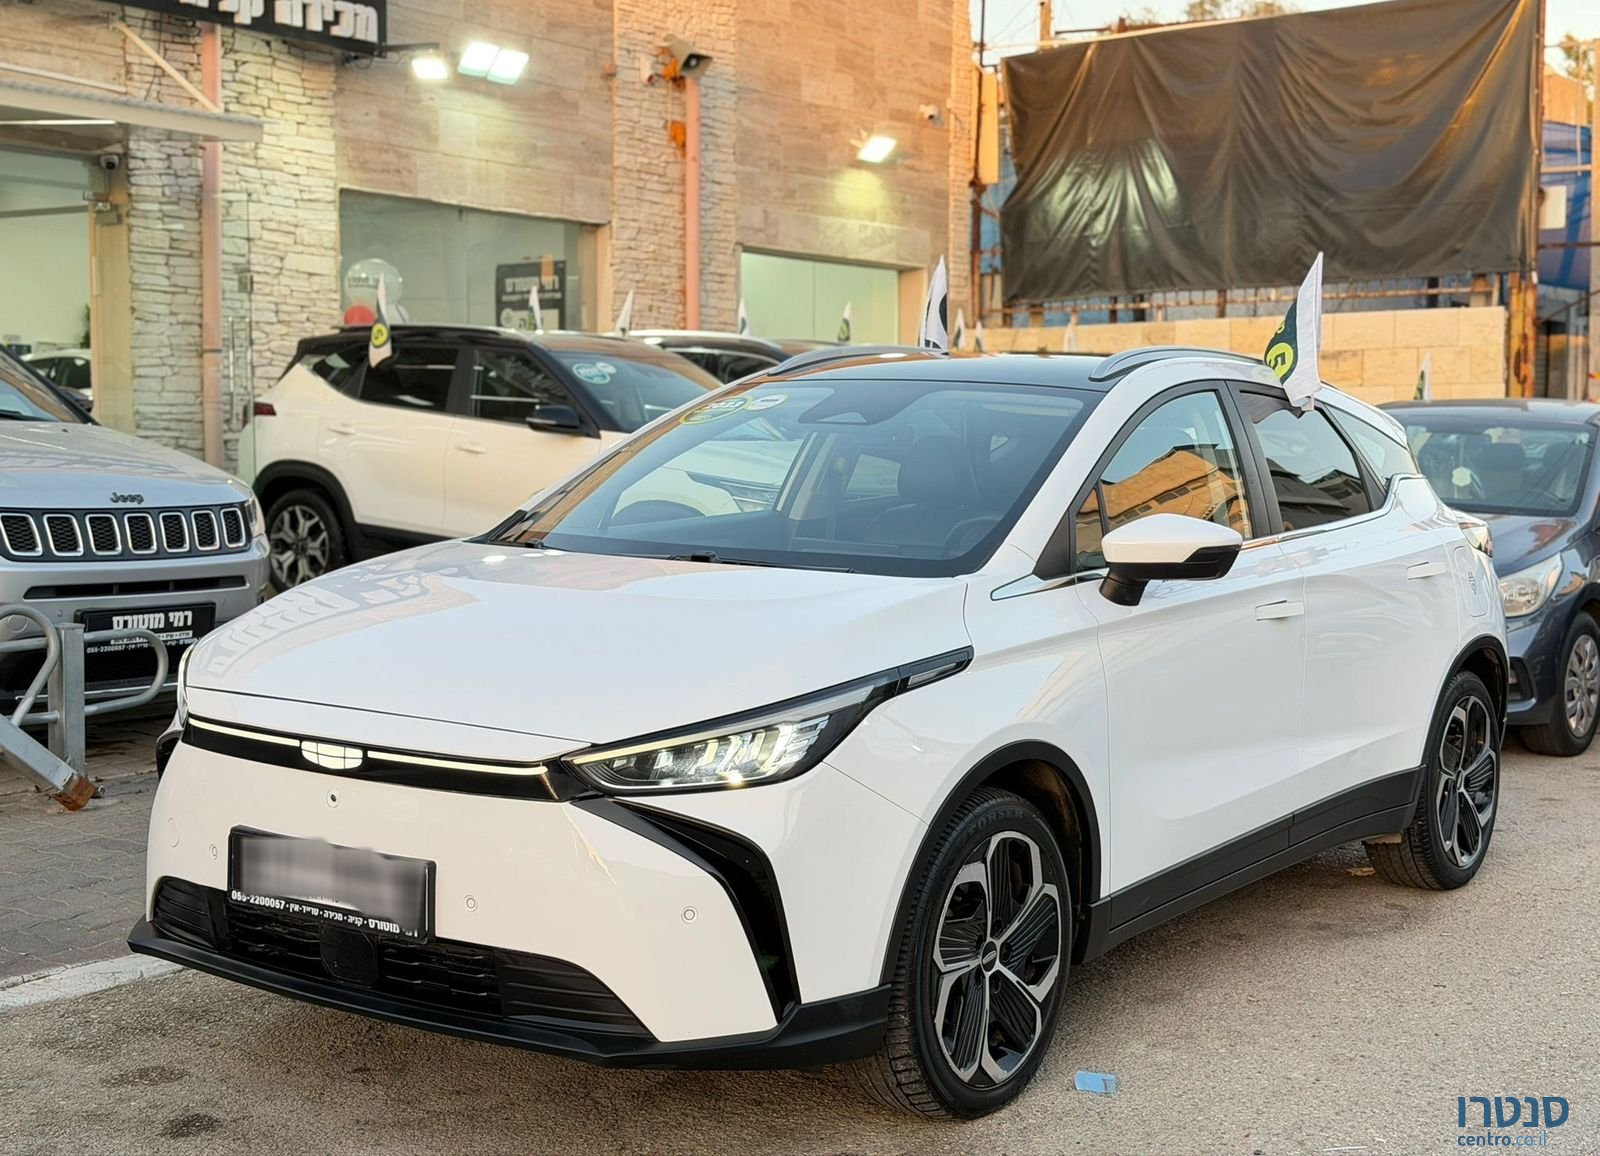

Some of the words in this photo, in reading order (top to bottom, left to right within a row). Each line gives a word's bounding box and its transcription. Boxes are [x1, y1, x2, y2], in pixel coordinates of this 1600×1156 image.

[109, 491, 145, 505] Jeep
[112, 612, 165, 630] מוטורס
[168, 610, 193, 627] רמי
[231, 890, 286, 910] 055-2200057
[368, 918, 400, 933] מוטורס
